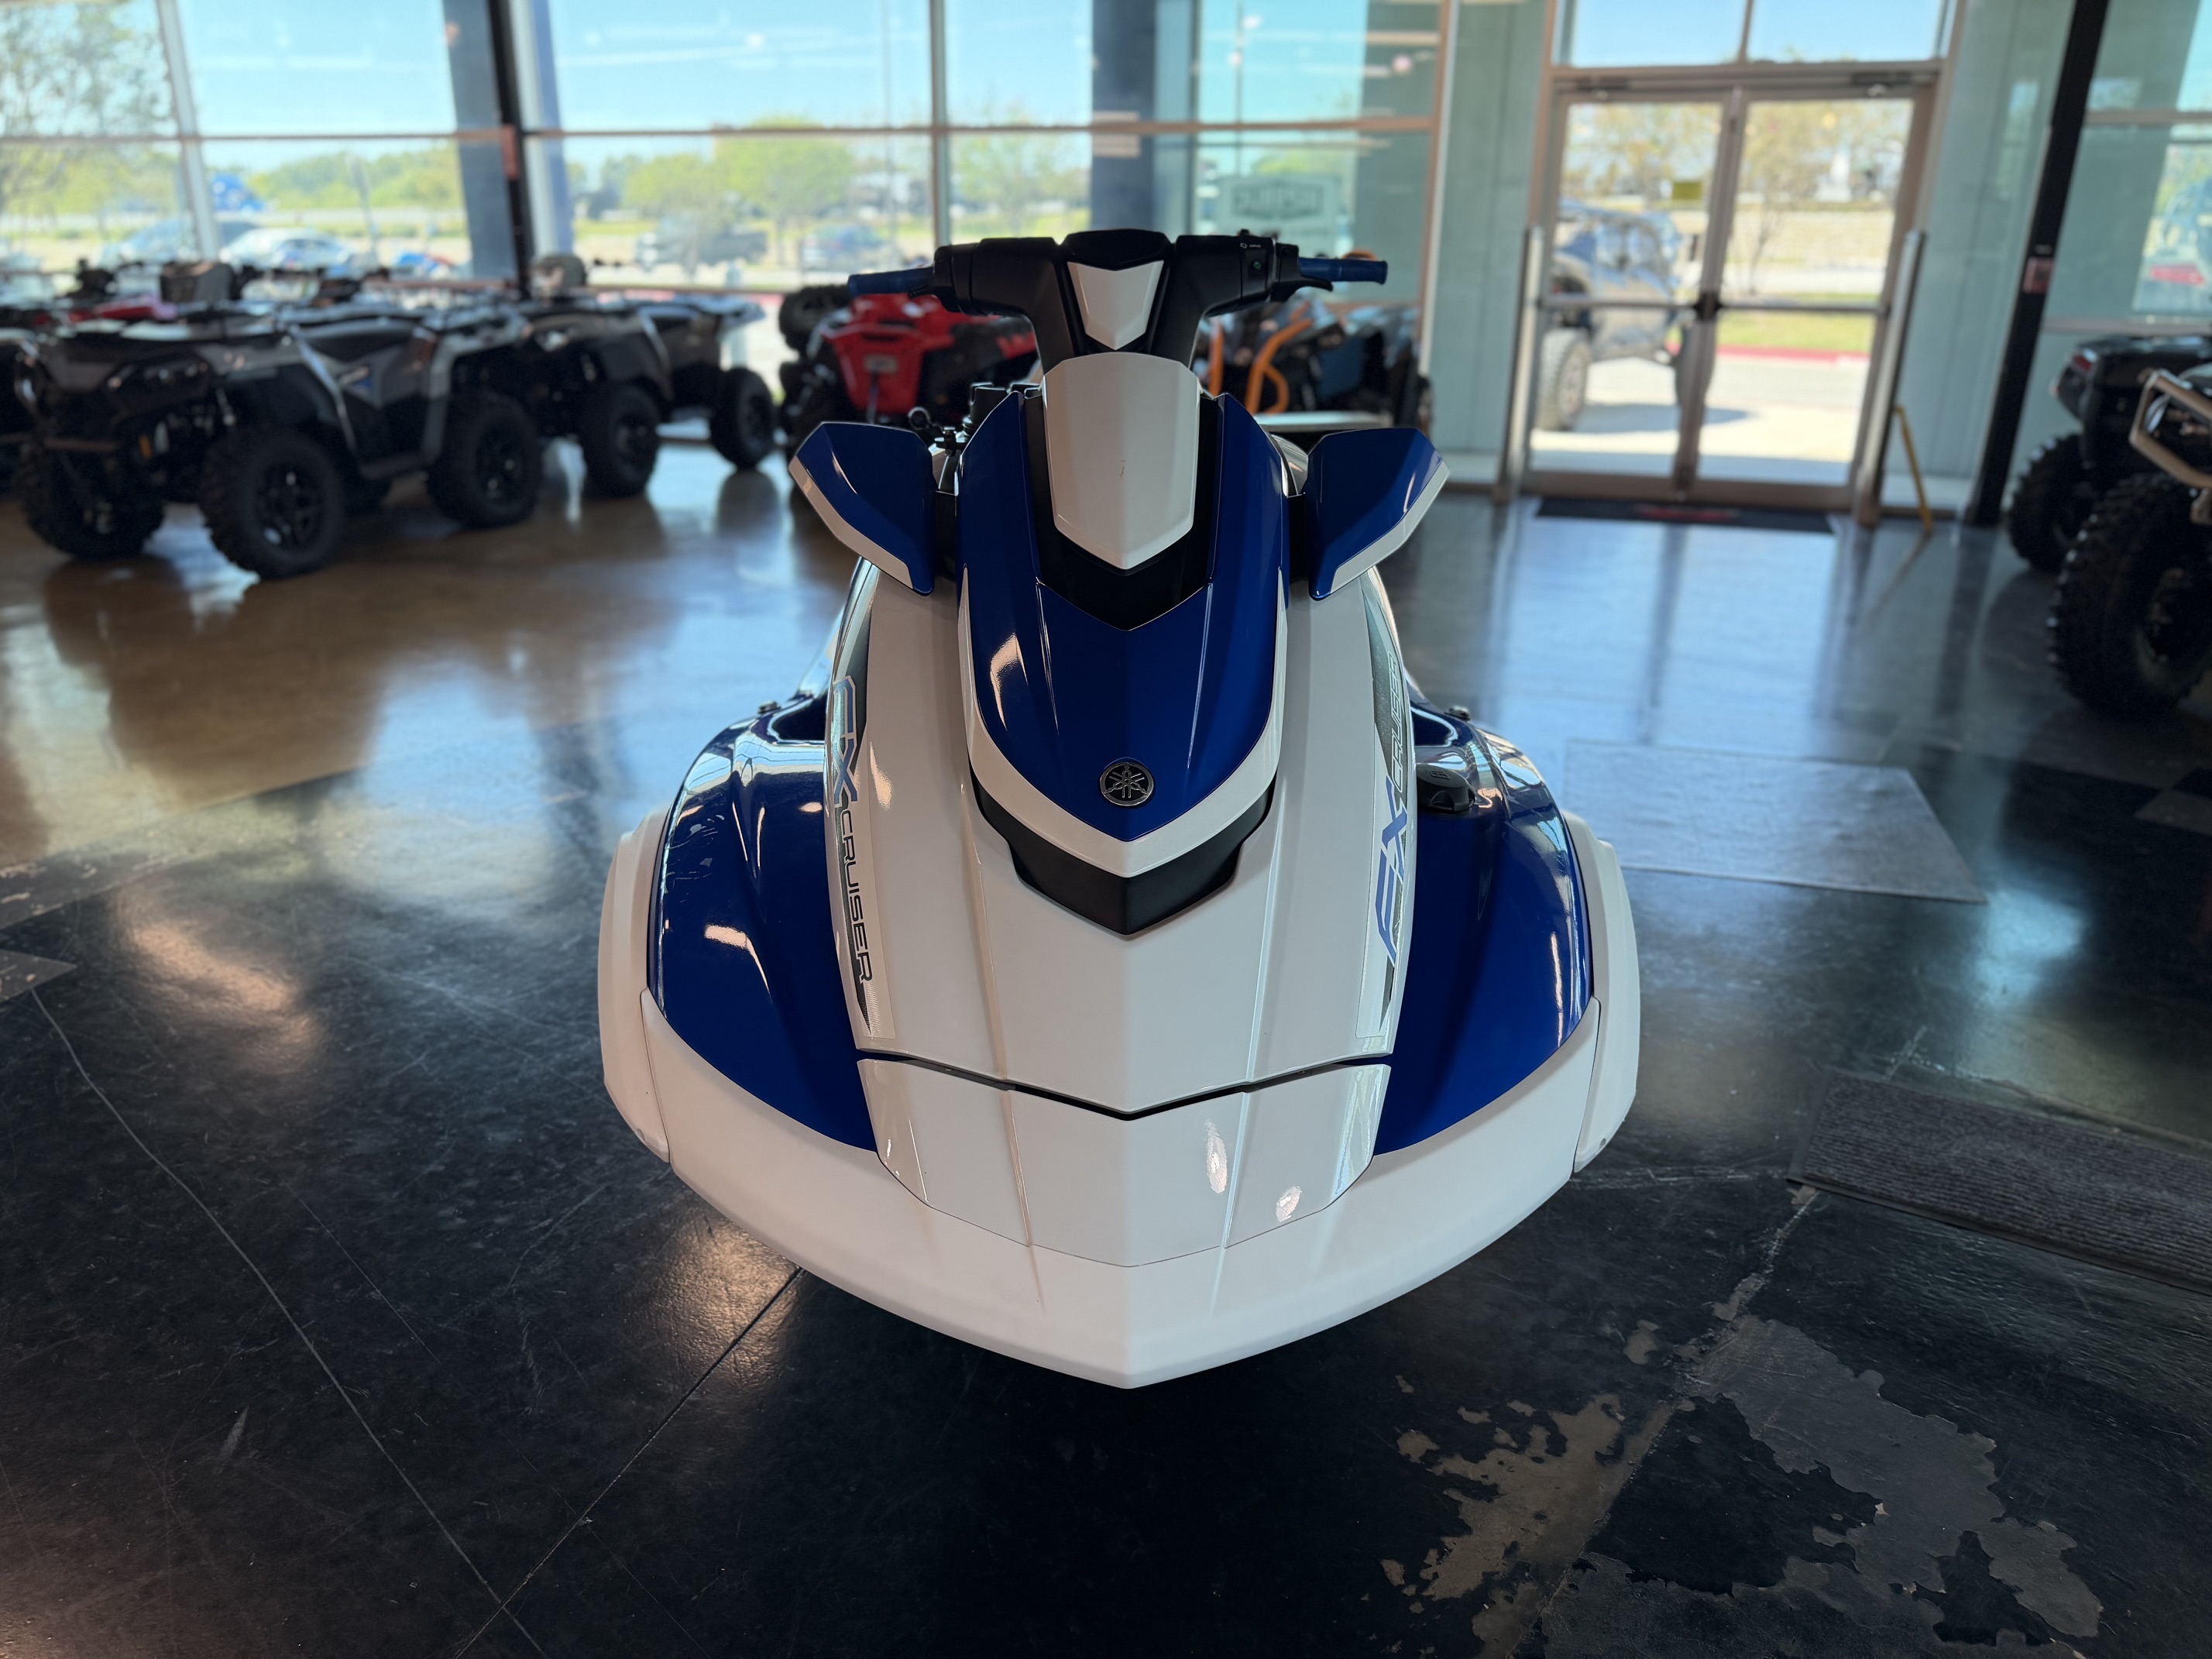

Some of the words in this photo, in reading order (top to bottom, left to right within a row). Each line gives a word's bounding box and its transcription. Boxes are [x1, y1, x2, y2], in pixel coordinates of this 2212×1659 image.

[833, 676, 858, 806] FX
[1388, 651, 1403, 793] CRUISER
[841, 808, 873, 984] CRUISER
[1375, 775, 1407, 967] FX
